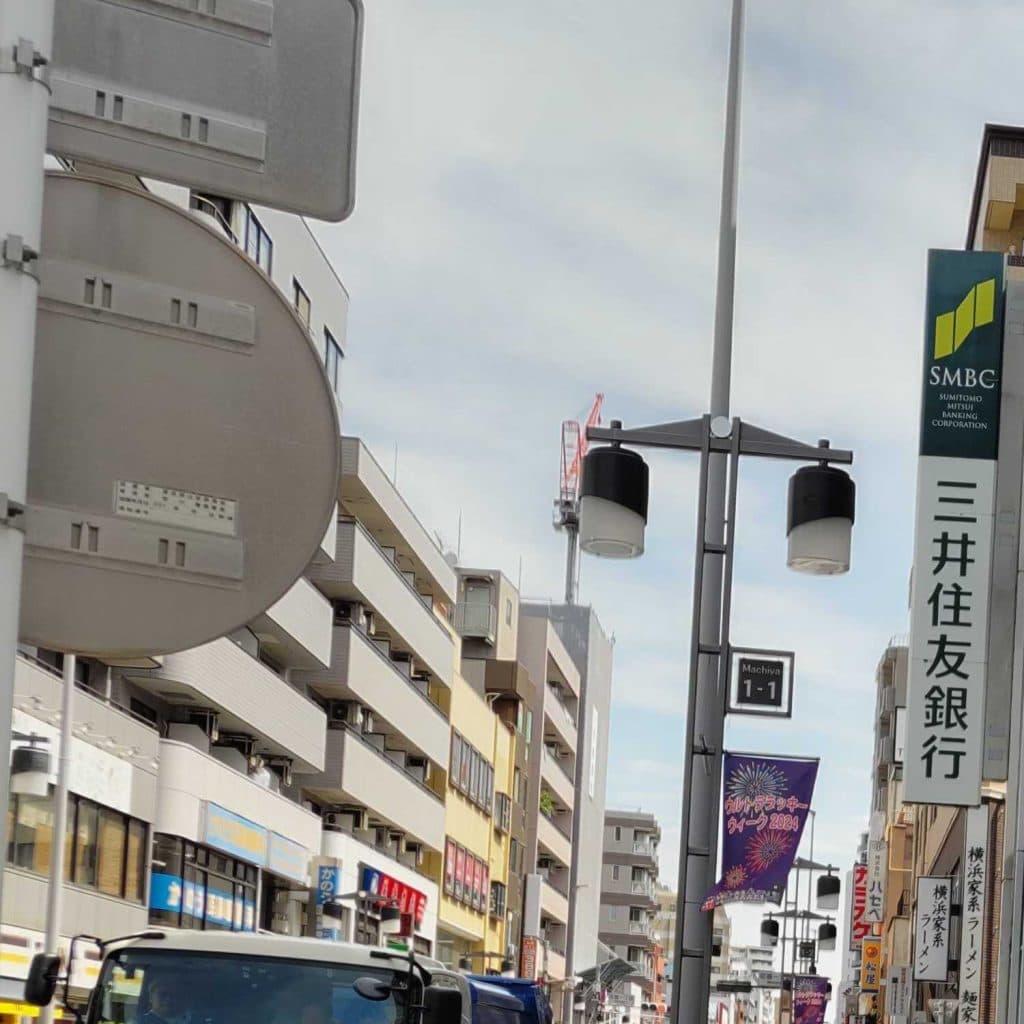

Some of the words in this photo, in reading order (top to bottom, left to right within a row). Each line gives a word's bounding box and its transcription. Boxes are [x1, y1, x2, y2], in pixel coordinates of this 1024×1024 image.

[929, 365, 997, 389] SMBC
[939, 393, 983, 403] SUMITOMO
[947, 402, 974, 412] MITSUI
[931, 419, 988, 430] CORPORATION
[942, 411, 978, 420] BANKING
[920, 480, 977, 780] 三井住友銀行
[742, 663, 781, 677] Machiya
[743, 678, 777, 700] 1-1
[769, 813, 799, 832] 2024
[932, 884, 948, 948] 横浜家系
[918, 913, 932, 975] ラーメン
